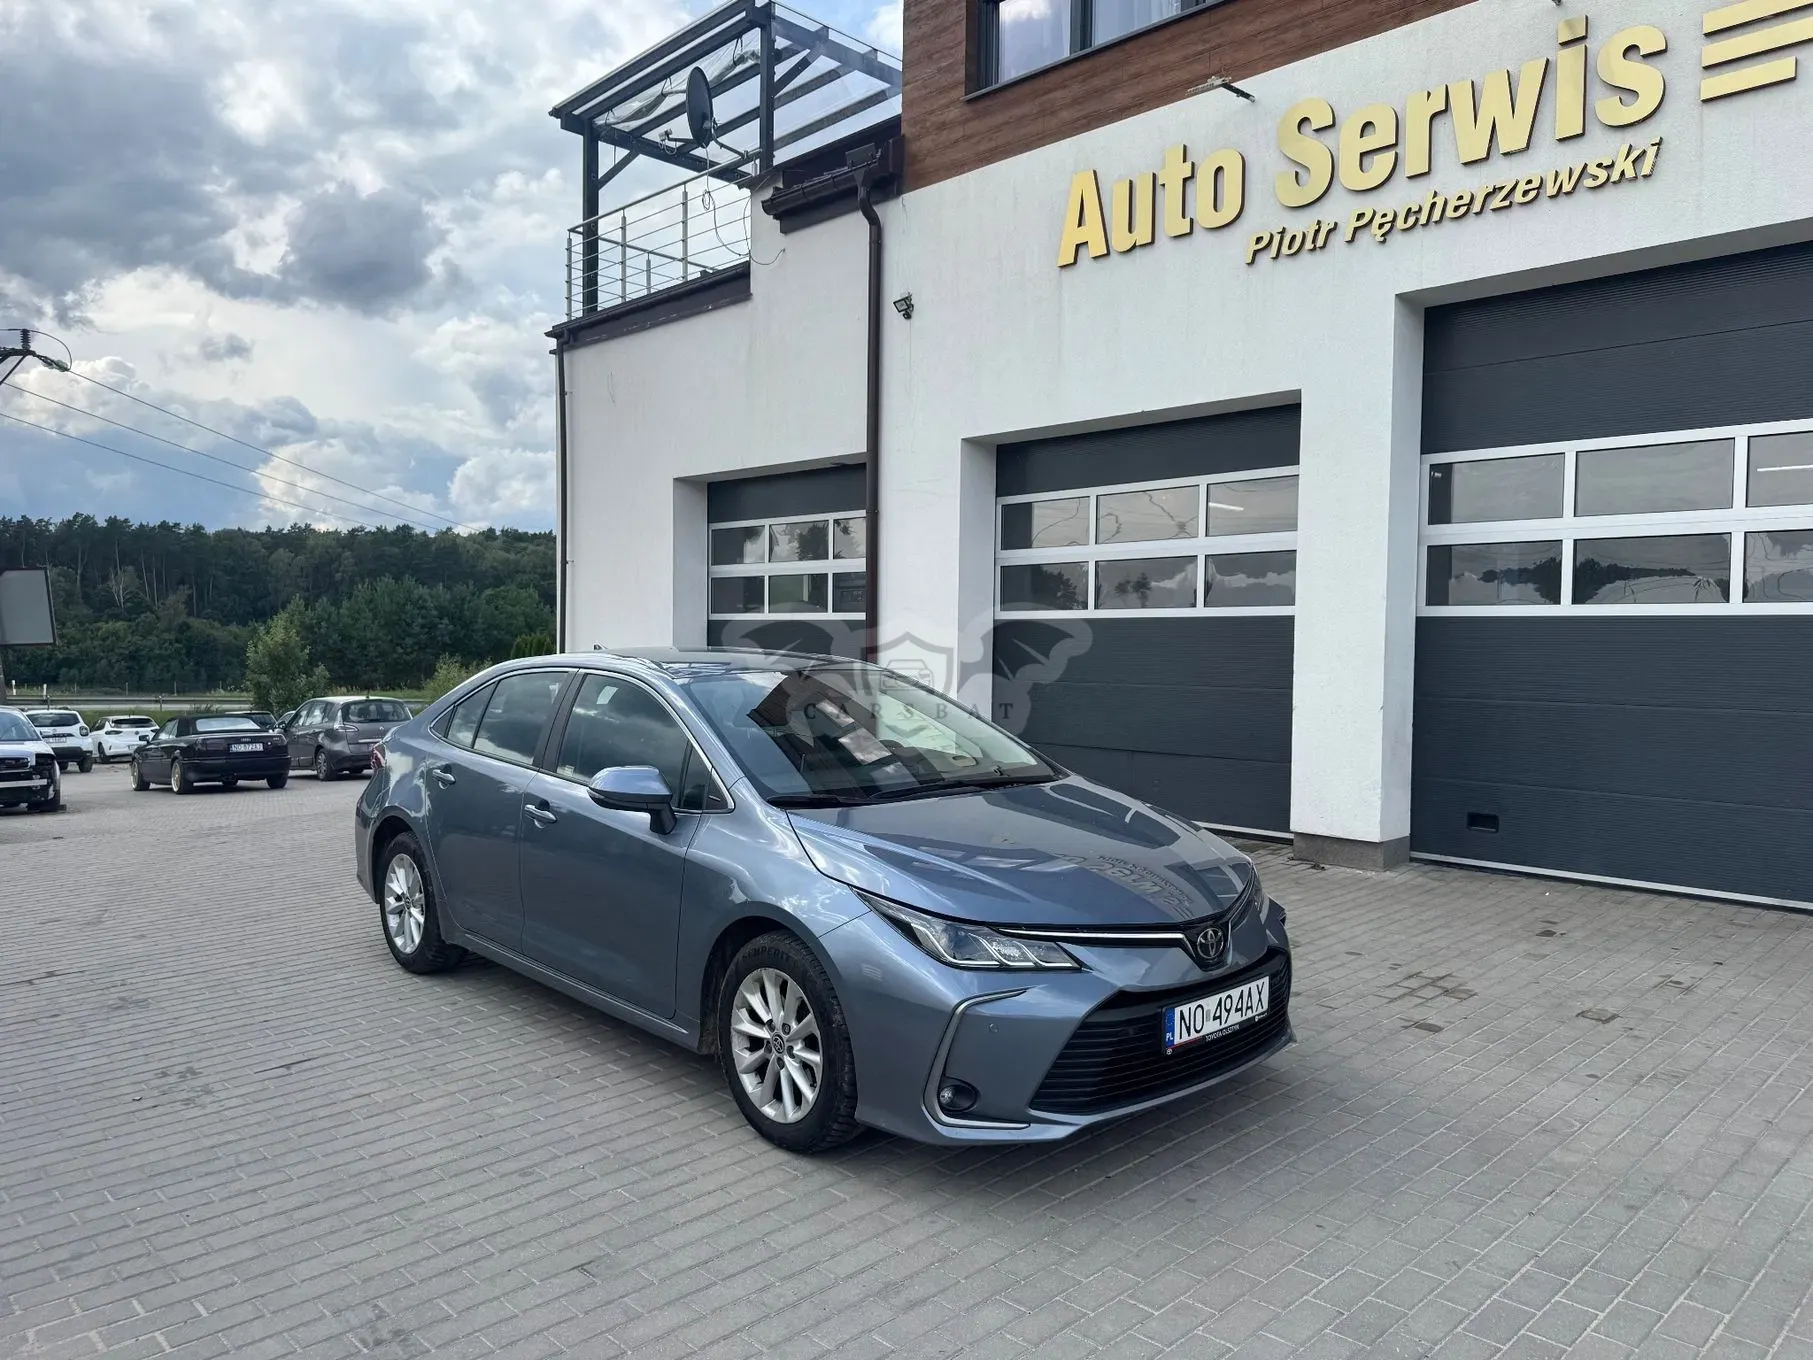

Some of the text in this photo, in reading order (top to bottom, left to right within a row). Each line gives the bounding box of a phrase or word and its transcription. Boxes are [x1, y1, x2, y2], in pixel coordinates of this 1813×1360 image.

[1057, 15, 1667, 267] Auto Serwis
[1246, 136, 1662, 265] Piotr Pęcherzewski
[1165, 1032, 1174, 1042] PL
[1179, 981, 1265, 1040] NO 494AX
